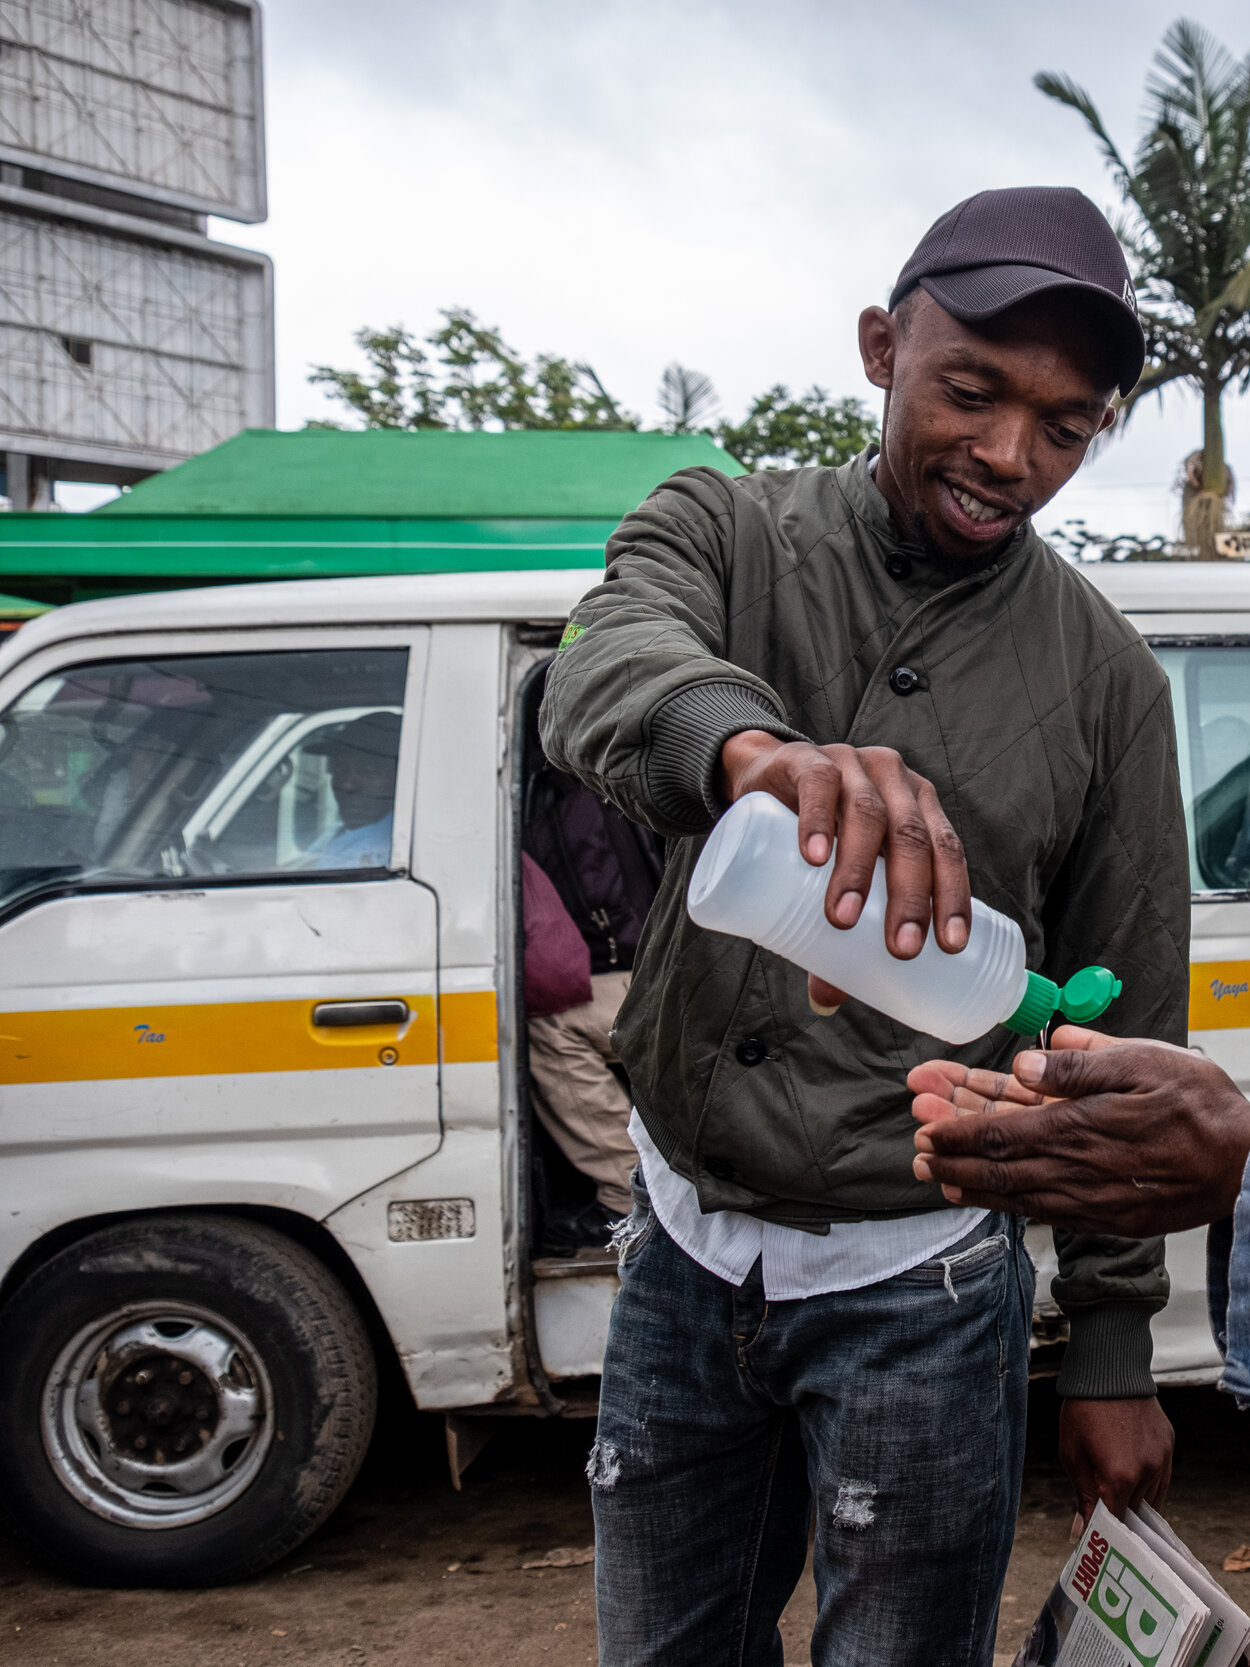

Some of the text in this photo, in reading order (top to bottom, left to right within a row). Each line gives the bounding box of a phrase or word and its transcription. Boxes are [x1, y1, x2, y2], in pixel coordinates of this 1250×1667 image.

[1210, 978, 1249, 1001] Yaya
[1071, 1530, 1109, 1602] SPORT
[1216, 1618, 1225, 1628] 10
